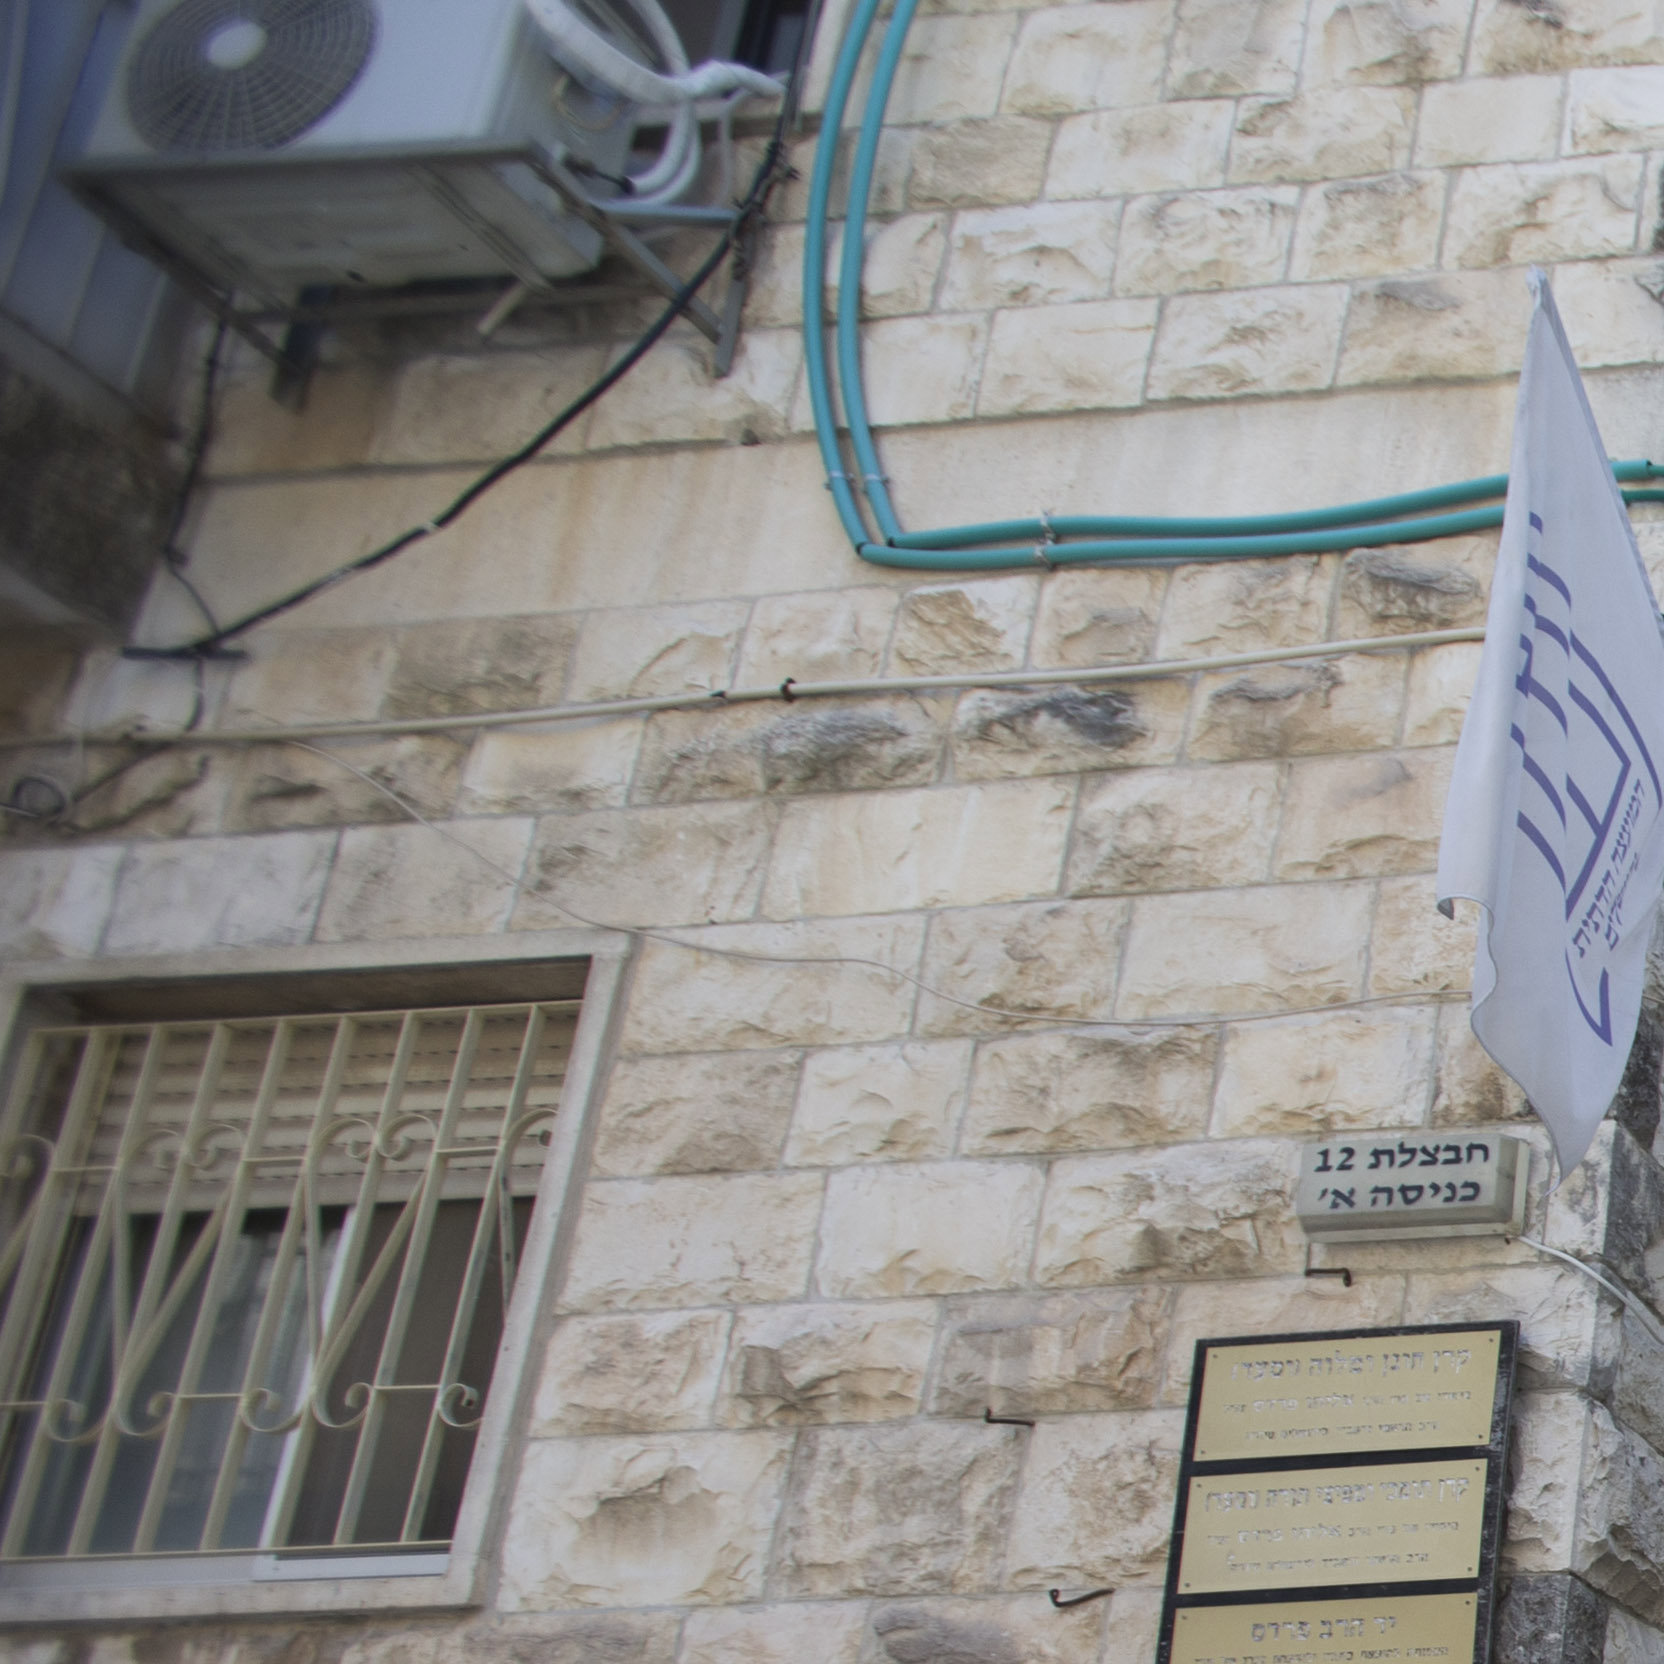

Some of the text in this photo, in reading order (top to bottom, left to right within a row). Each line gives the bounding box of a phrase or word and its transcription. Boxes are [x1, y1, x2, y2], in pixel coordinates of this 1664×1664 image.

[1572, 868, 1617, 959] הדתית
[1314, 1141, 1490, 1172] חבצלת 12
[1369, 1180, 1481, 1207] כניסה
[1433, 1349, 1472, 1374] קרן
[1438, 1478, 1470, 1503] קרן
[1250, 1616, 1398, 1643] יד הרב פרדס
